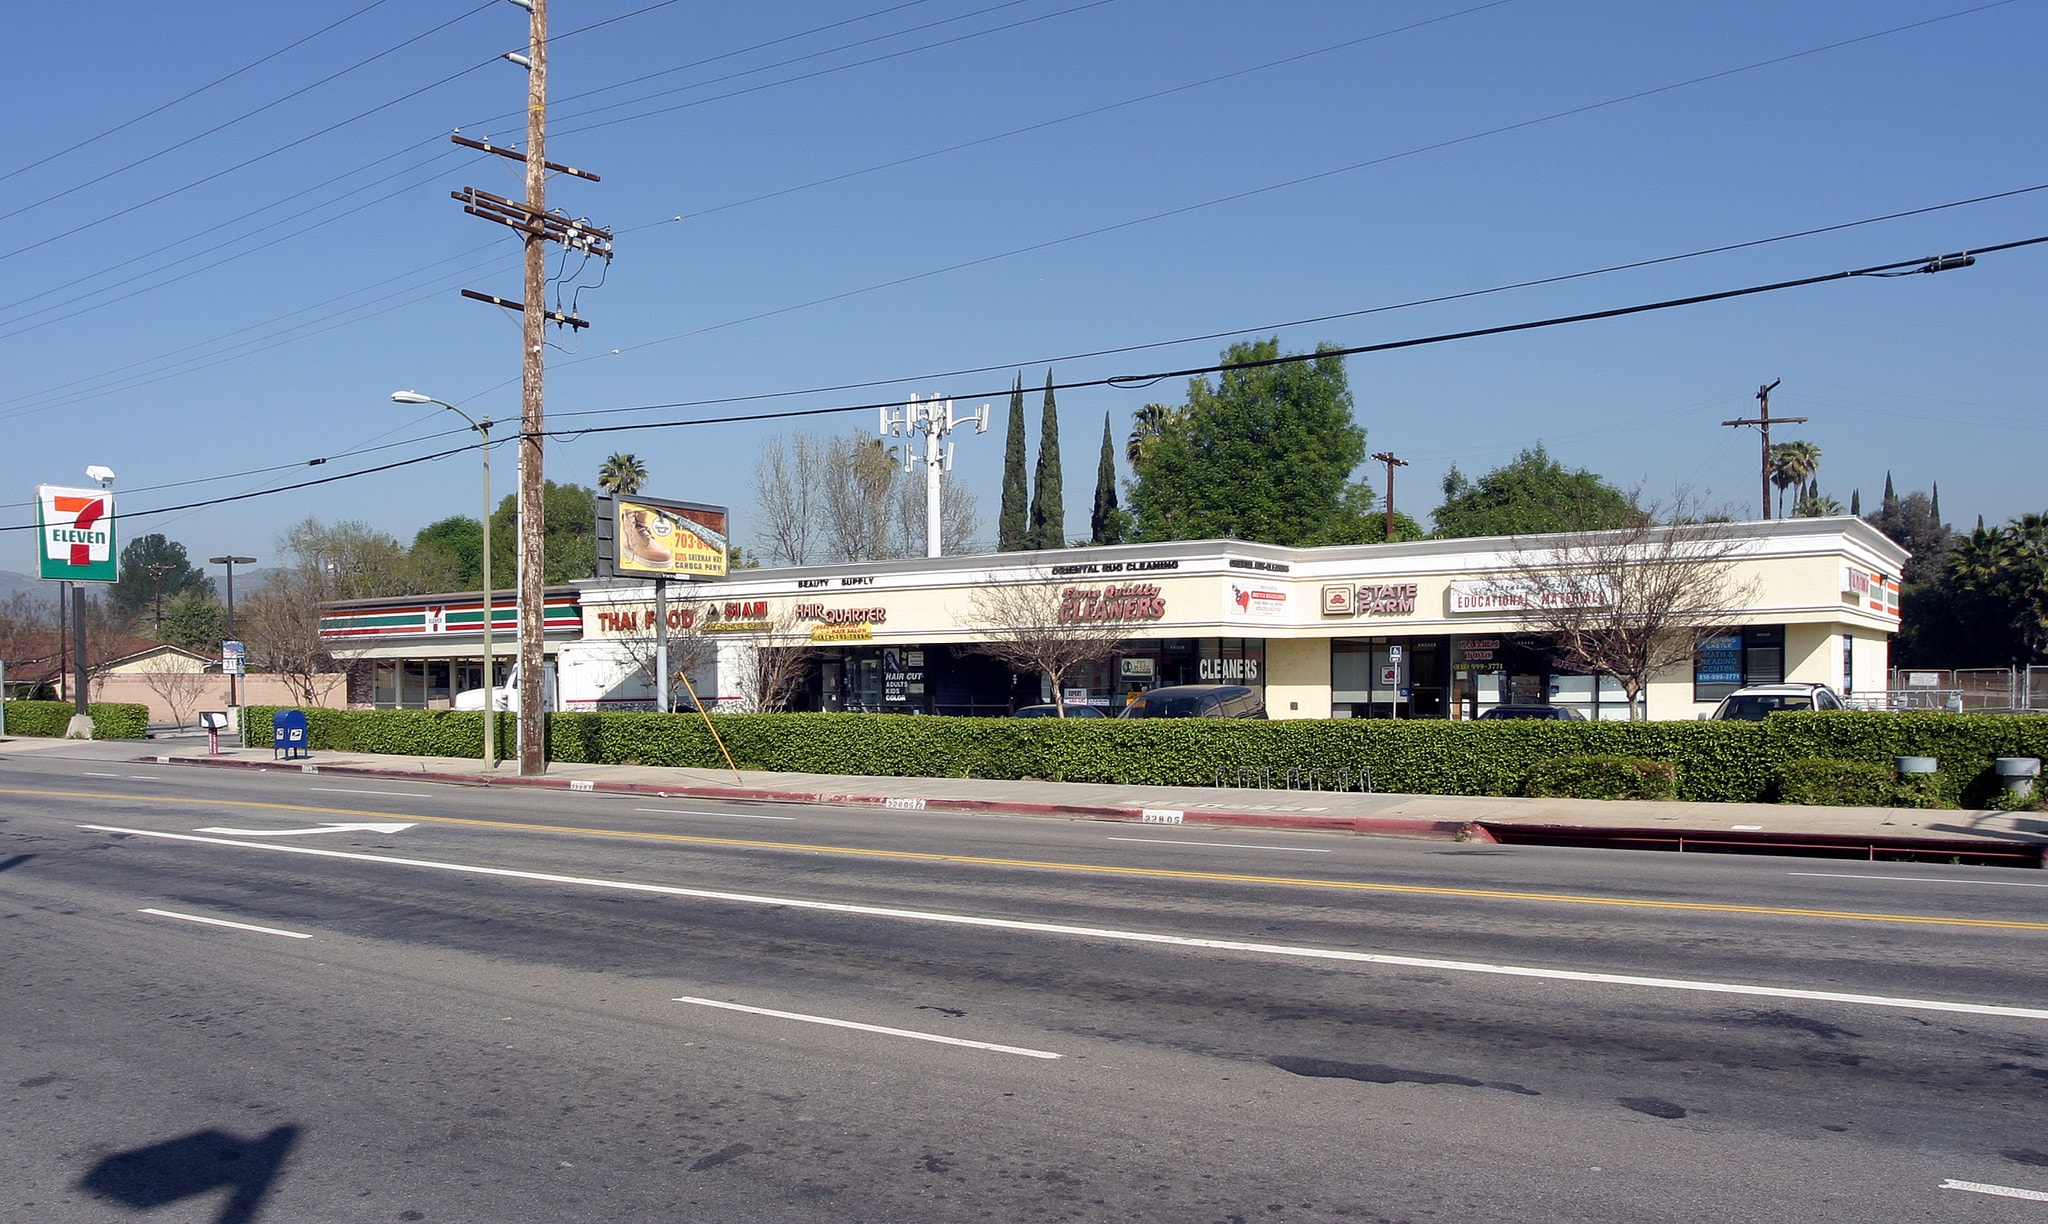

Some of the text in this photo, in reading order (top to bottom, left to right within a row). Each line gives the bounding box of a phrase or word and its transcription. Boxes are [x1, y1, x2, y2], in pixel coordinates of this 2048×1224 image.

[54, 495, 104, 566] 7
[675, 562, 702, 570] CANOGA
[1052, 560, 1178, 575] ORIENTAL RUG CLEANING
[798, 577, 874, 588] BEAUTY SUPPLY
[1105, 584, 1160, 599] Quality
[1359, 583, 1417, 599] STATE
[1359, 599, 1414, 613] FARM
[1458, 593, 1529, 609] EDUCATIONAL
[724, 602, 768, 618] SIAM
[795, 603, 886, 623] HAIR QUARTER
[1059, 599, 1166, 621] CLEANERS
[598, 611, 637, 632] THAI
[1458, 640, 1500, 649] GAMES
[1465, 651, 1493, 660] TOYS
[885, 672, 905, 680] HAIR
[1200, 659, 1258, 680] CLEANERS
[885, 694, 907, 702] COLOR
[1144, 815, 1181, 824] 22805
